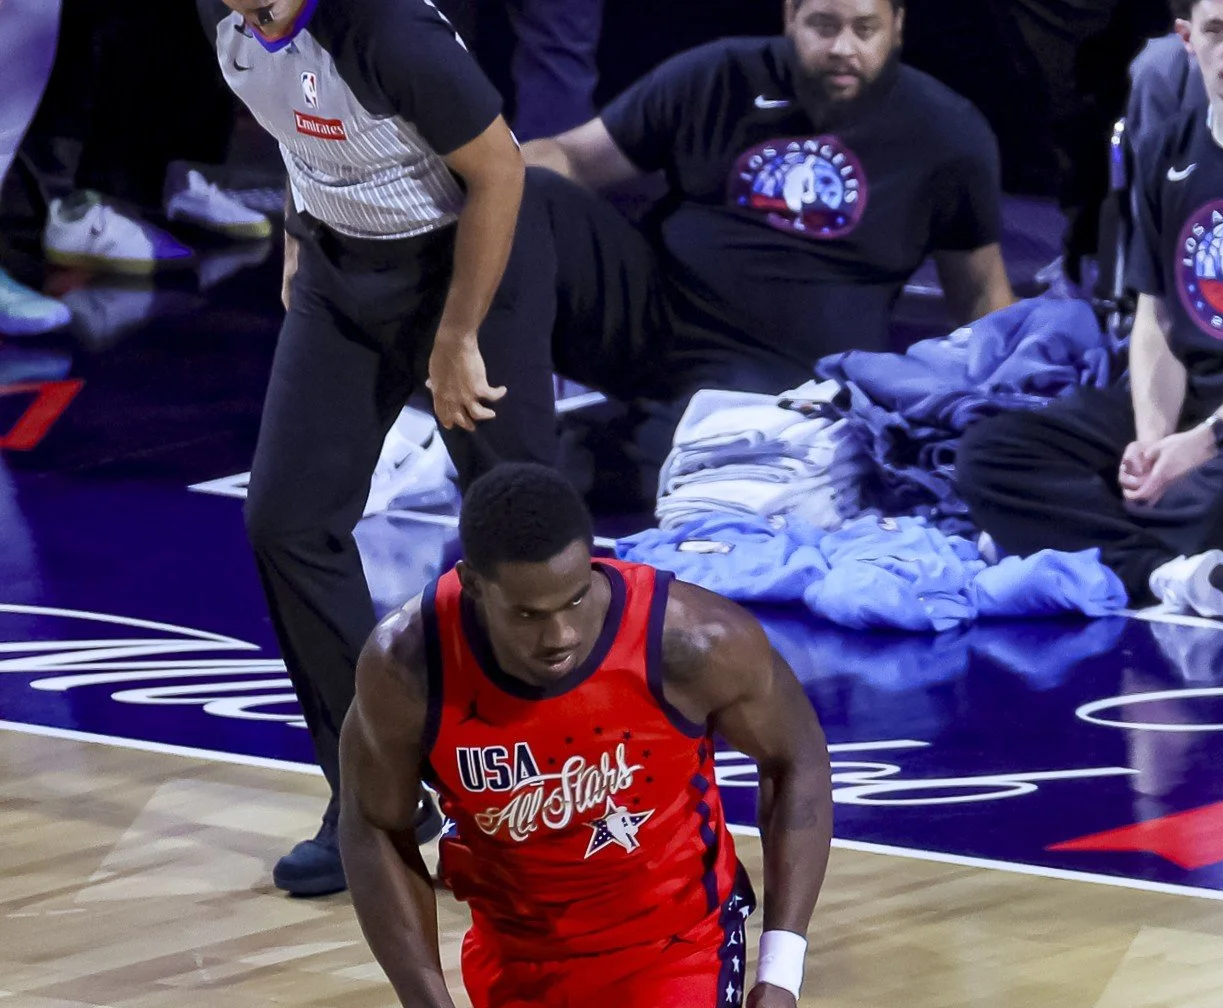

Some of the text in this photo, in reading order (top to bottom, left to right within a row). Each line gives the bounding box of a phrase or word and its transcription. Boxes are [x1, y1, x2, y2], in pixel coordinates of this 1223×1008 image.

[295, 114, 344, 135] Emirates
[1182, 222, 1205, 267] LOS
[456, 741, 544, 793] USA
[474, 742, 645, 842] All Stars
